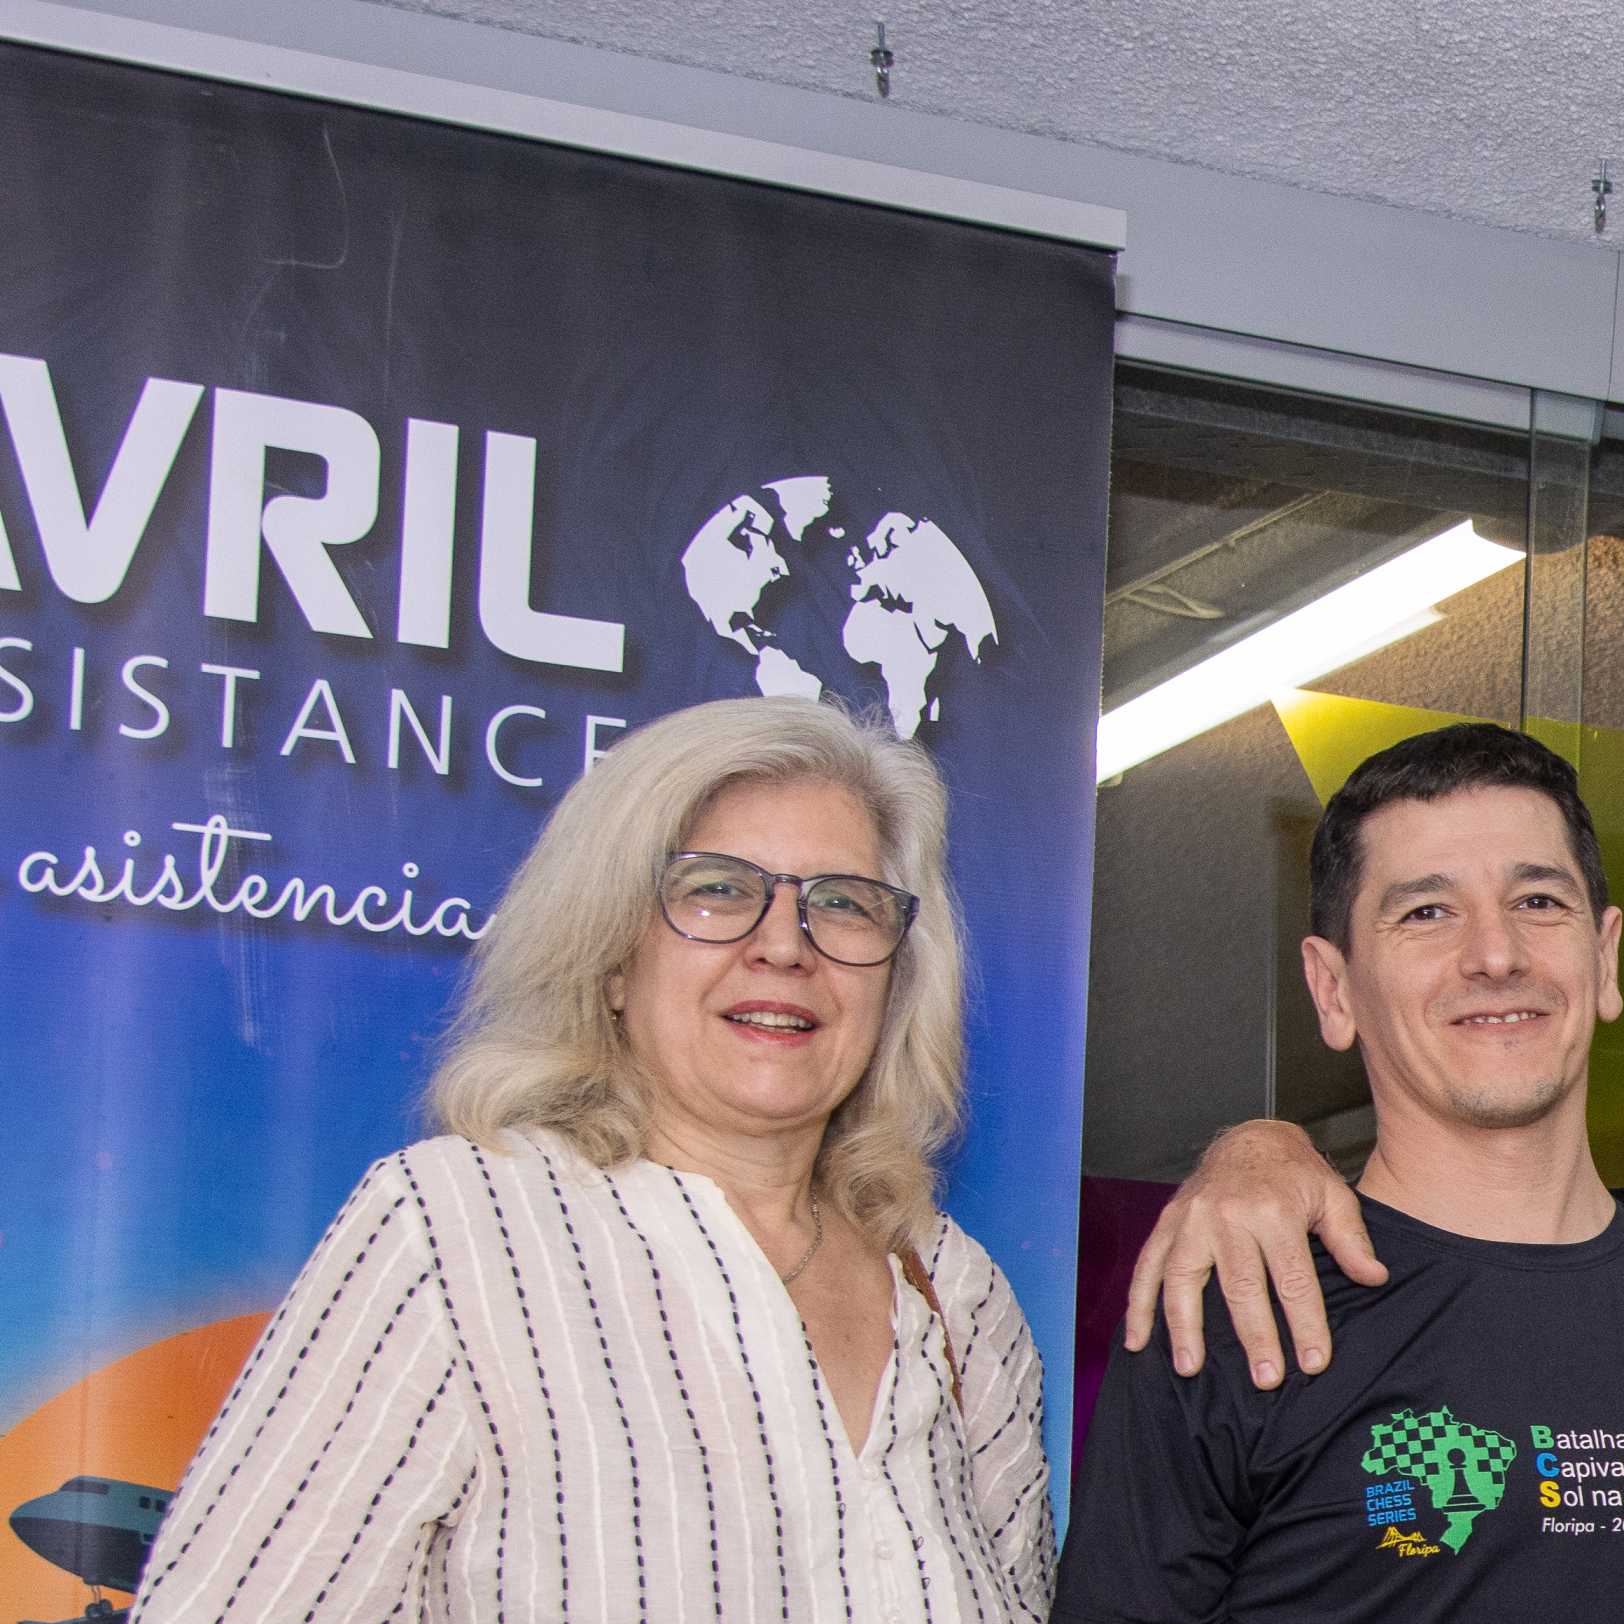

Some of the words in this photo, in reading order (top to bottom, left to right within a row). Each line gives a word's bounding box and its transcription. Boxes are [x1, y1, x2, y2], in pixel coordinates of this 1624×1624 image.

[0, 354, 624, 673] VRIL
[18, 815, 498, 942] asistencia
[1366, 1480, 1415, 1498] BRAZIL
[1539, 1480, 1584, 1508] Sol
[1592, 1488, 1622, 1507] na
[1366, 1494, 1412, 1513] CHESS
[1368, 1509, 1417, 1527] SERIES
[1541, 1518, 1595, 1536] Floripa
